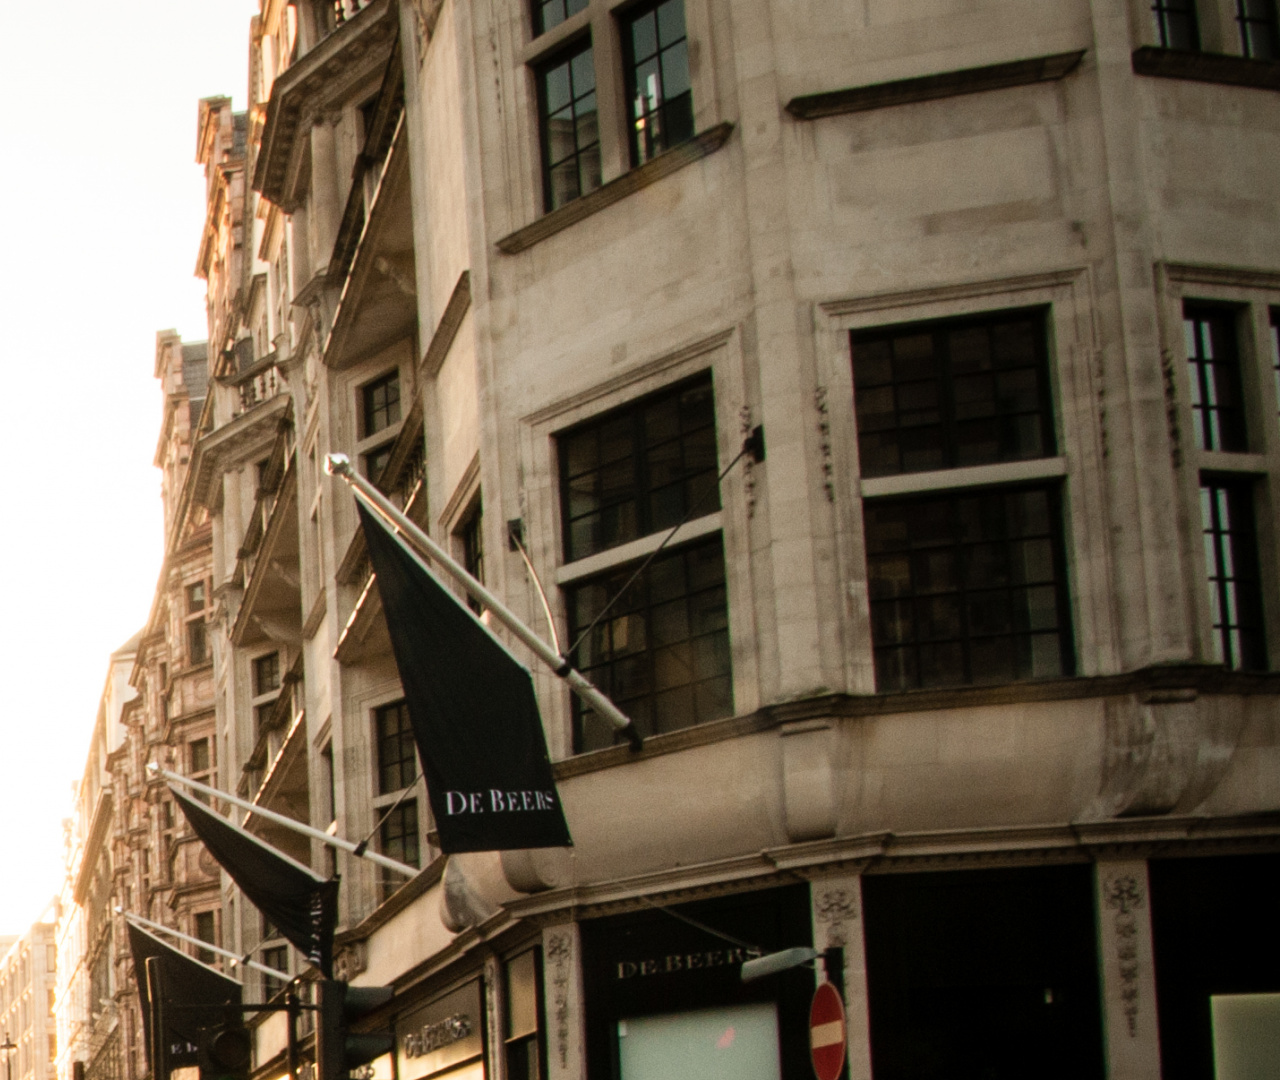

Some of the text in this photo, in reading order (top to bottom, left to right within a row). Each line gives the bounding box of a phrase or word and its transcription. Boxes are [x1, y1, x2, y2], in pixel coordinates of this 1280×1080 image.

[443, 789, 554, 815] DE BEERS
[618, 947, 762, 979] DE BEERS
